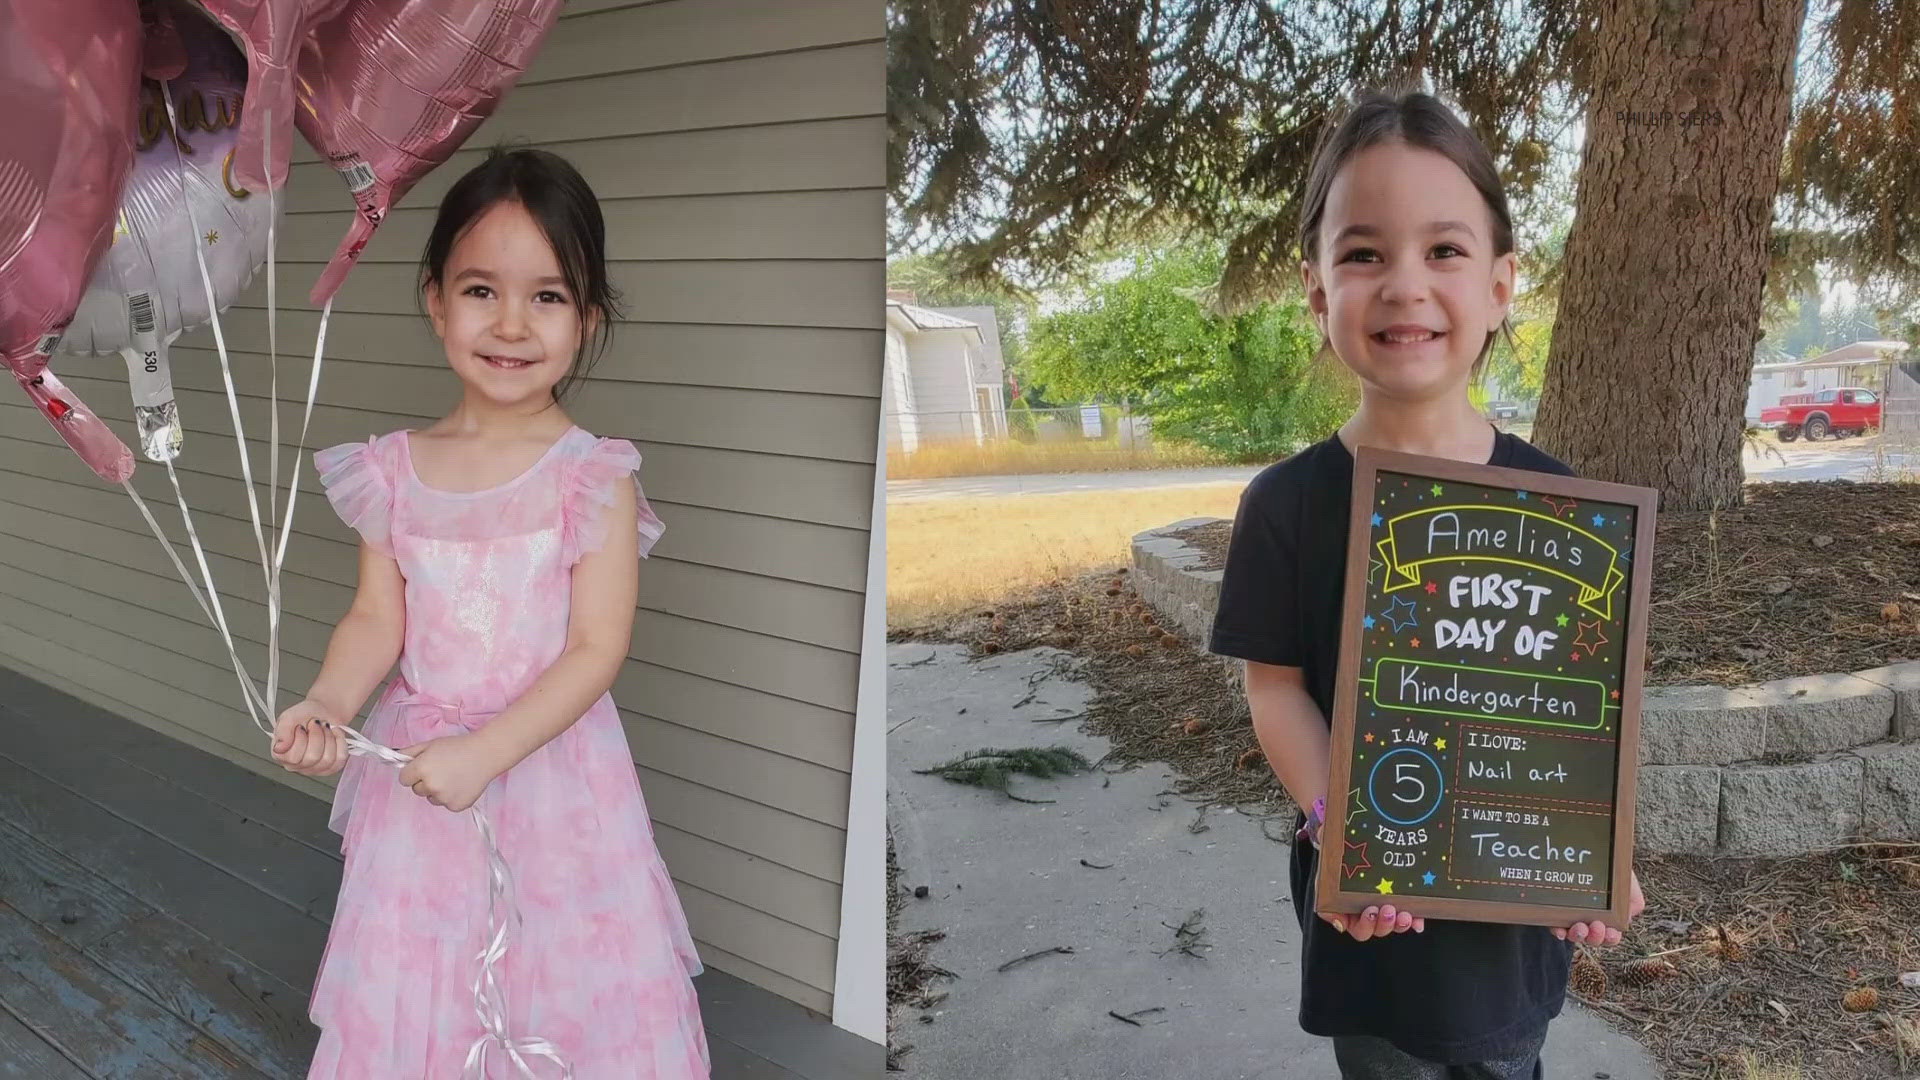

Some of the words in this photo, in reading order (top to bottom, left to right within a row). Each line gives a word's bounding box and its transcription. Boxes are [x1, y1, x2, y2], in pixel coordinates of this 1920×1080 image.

[144, 350, 158, 373] 530
[1427, 512, 1582, 566] Amelia's
[1448, 573, 1552, 616] FIRST
[1434, 617, 1507, 653] DAY
[1514, 625, 1559, 661] OF
[1399, 665, 1577, 716] Kindergarten
[1391, 728, 1400, 743] I
[1405, 729, 1430, 746] AM
[1467, 732, 1477, 747] I
[1481, 733, 1527, 751] LOVE:
[1391, 763, 1426, 803] 5
[1468, 760, 1512, 780] Nail
[1528, 763, 1568, 783] art
[1461, 808, 1468, 820] I
[1472, 809, 1502, 823] WANT
[1505, 812, 1521, 824] TO
[1523, 813, 1540, 826] BE
[1541, 815, 1550, 827] A
[1374, 824, 1429, 846] YEARS
[1383, 850, 1416, 867] OLD
[1470, 832, 1592, 864] Teacher
[1499, 866, 1532, 881] WHEN
[1533, 868, 1541, 881] I
[1544, 870, 1575, 884] GROW
[1578, 873, 1594, 885] UP
